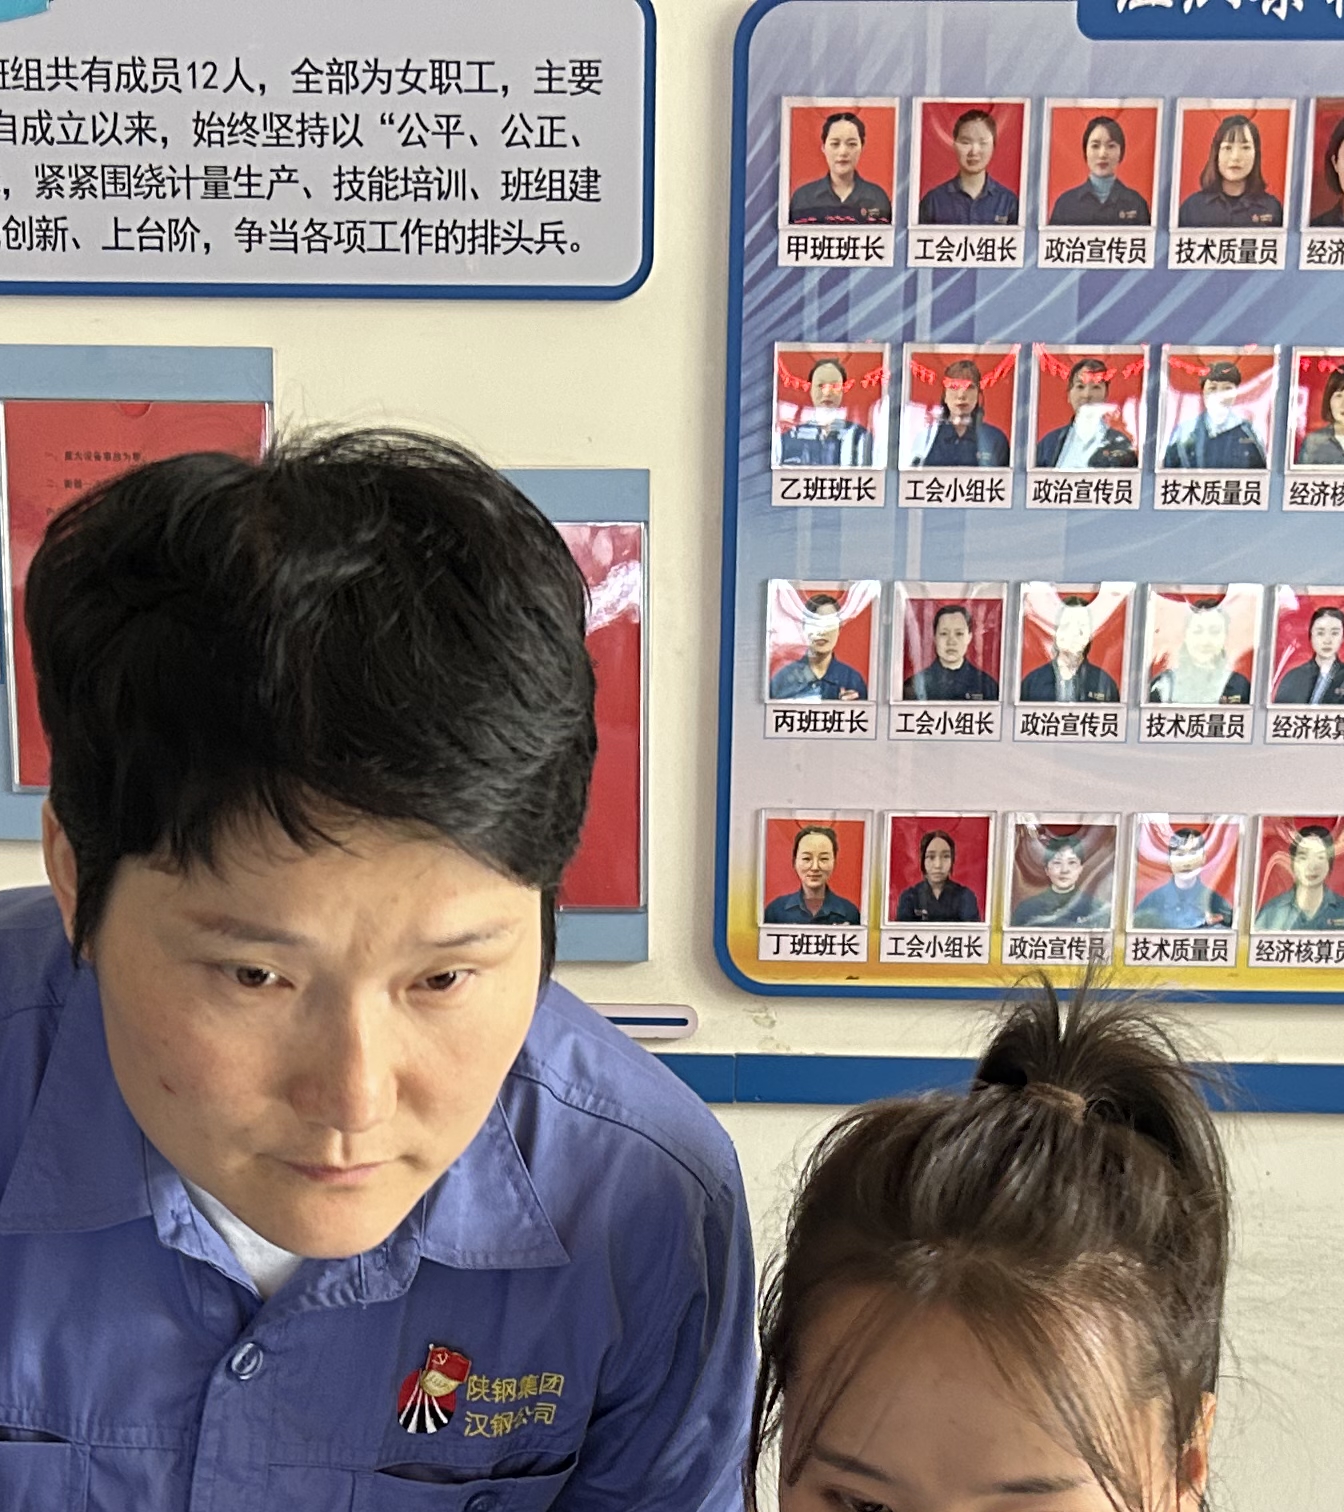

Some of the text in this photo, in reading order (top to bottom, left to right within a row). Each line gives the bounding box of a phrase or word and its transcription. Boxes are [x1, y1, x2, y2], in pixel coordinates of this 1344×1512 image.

[786, 235, 886, 262] 甲班班长
[913, 236, 1018, 262] 工会小组长
[1043, 237, 1147, 264] 政治宣传员
[1175, 238, 1278, 265] 技术质量员
[779, 476, 877, 502] 乙班班长
[904, 477, 1006, 503] 工会小组长
[1031, 478, 1133, 505] 政治宣传员
[1160, 479, 1262, 506] 技术质量员
[771, 709, 870, 734] 丙班班长
[895, 710, 994, 735] 工会小组长
[1019, 712, 1119, 737] 政治宣传员
[1145, 713, 1245, 739] 技术质量员
[765, 933, 860, 957] 丁班班长
[886, 934, 984, 958] 工会小组长
[1007, 936, 1105, 960] 政治宣传员
[1131, 937, 1229, 962] 技术质量员
[466, 1372, 564, 1403] 陕钢集团
[464, 1402, 556, 1438] 汉钢公司
